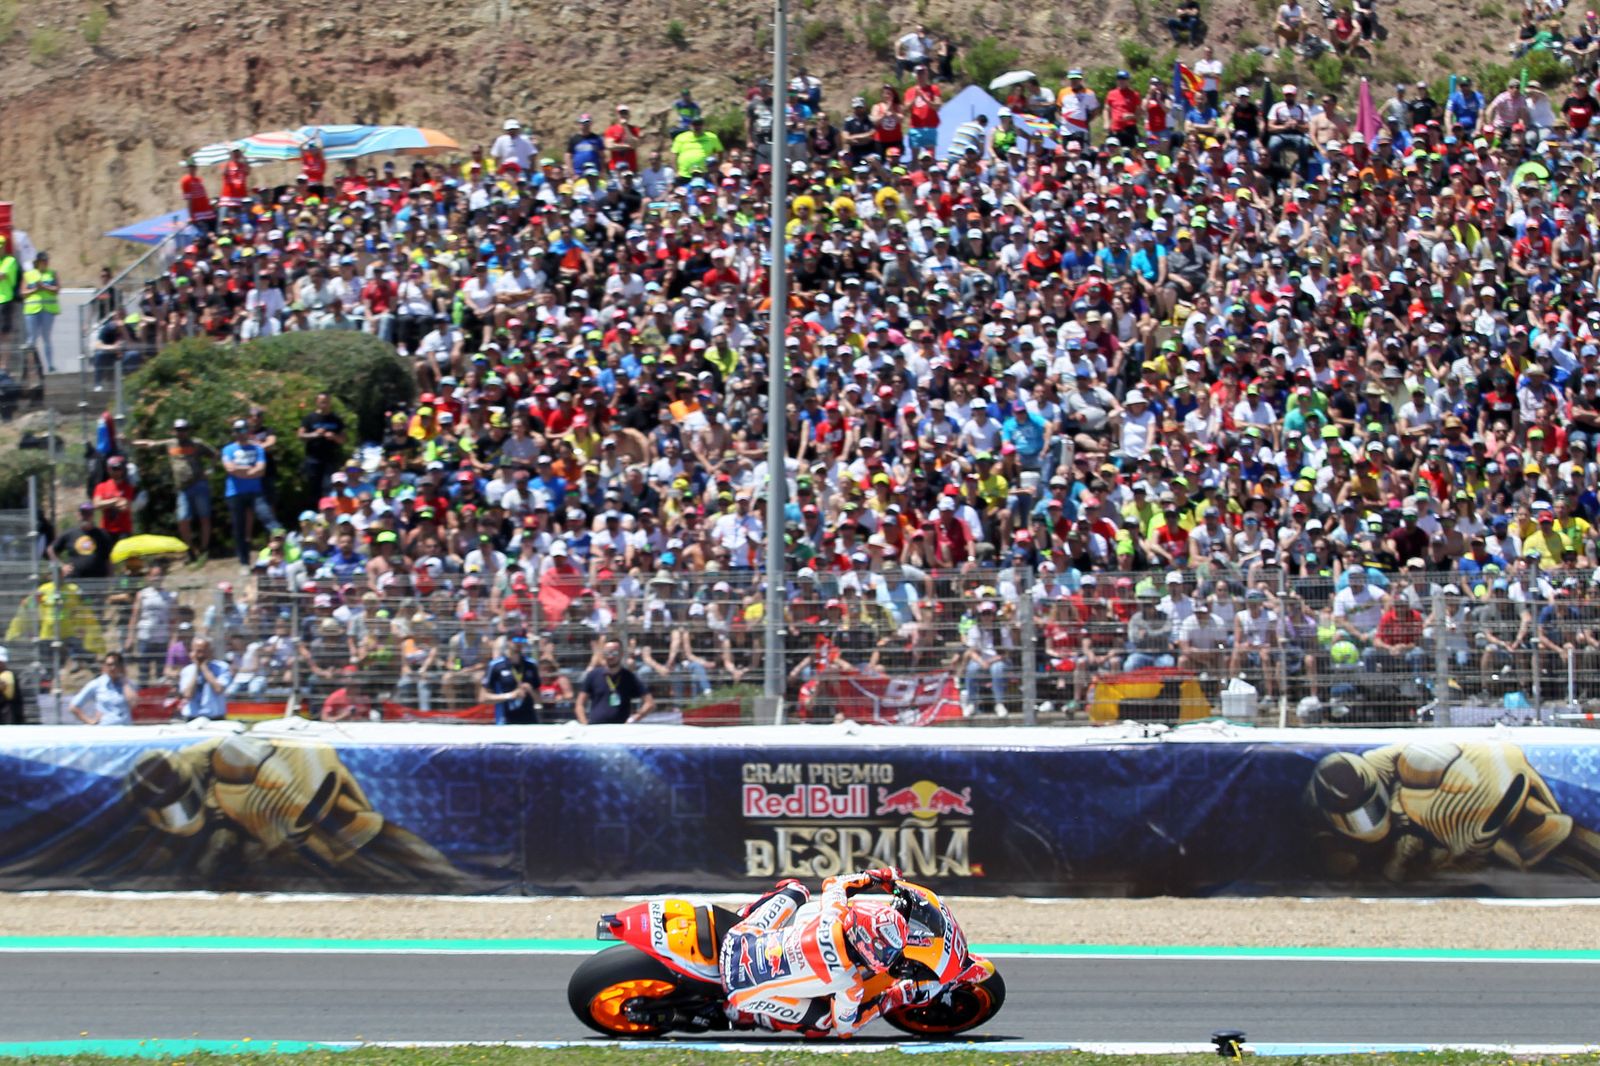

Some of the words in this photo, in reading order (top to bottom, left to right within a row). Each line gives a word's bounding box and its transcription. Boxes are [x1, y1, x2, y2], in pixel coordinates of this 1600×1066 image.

[742, 763, 802, 784] GRAN
[808, 763, 894, 788] PREMIO
[744, 784, 804, 816] Red
[809, 784, 868, 816] Bull
[651, 902, 664, 947] REPSOL
